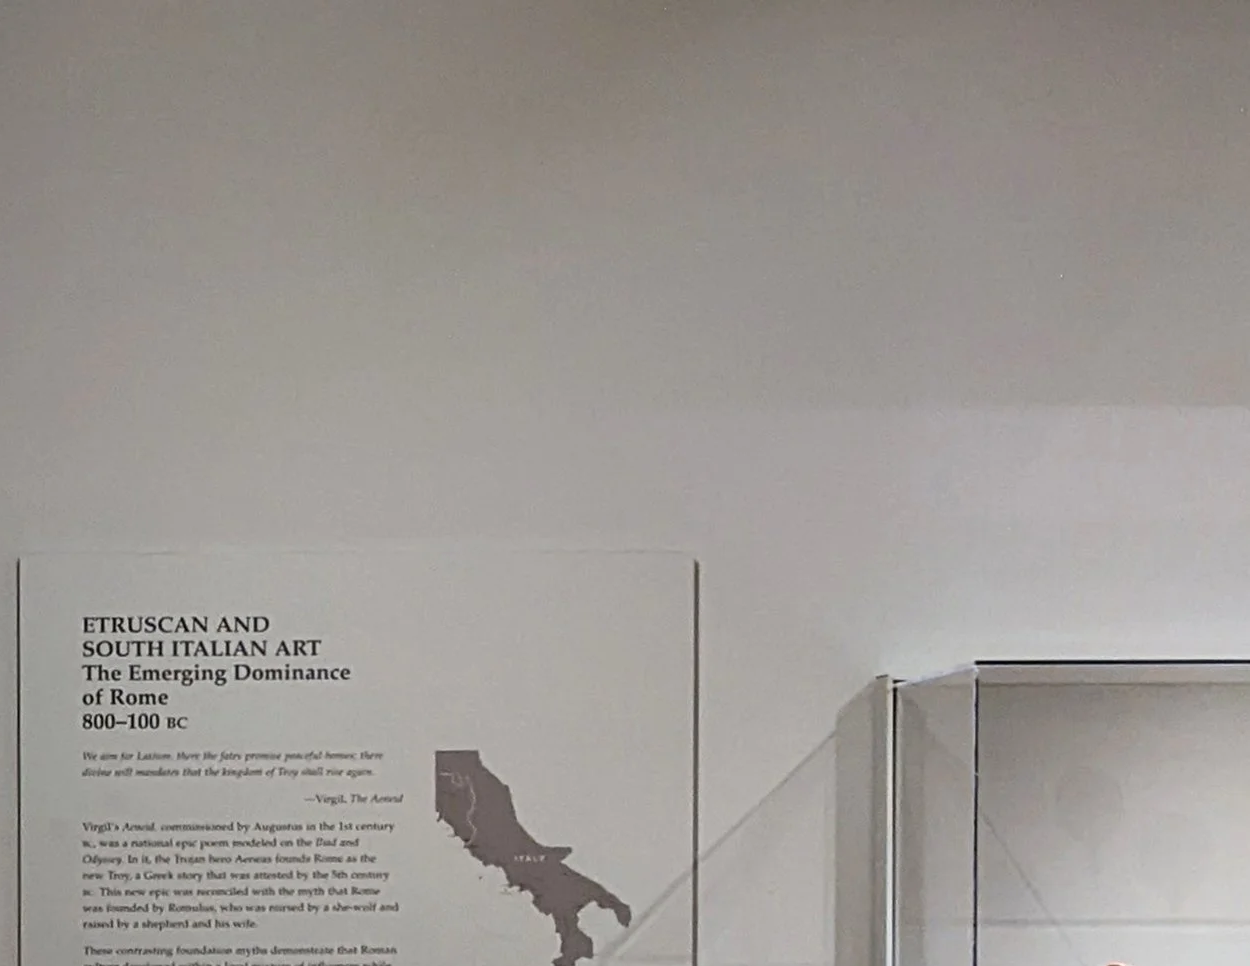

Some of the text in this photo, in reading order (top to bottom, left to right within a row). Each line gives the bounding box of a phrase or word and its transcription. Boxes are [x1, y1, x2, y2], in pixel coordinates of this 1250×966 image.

[83, 616, 269, 633] ETRUSCAN AND
[83, 640, 322, 657] SOUTH ITALIAN ART
[82, 664, 351, 686] The Emerging Dominance
[82, 688, 168, 706] of Rome
[82, 713, 188, 729] 800–100 BC
